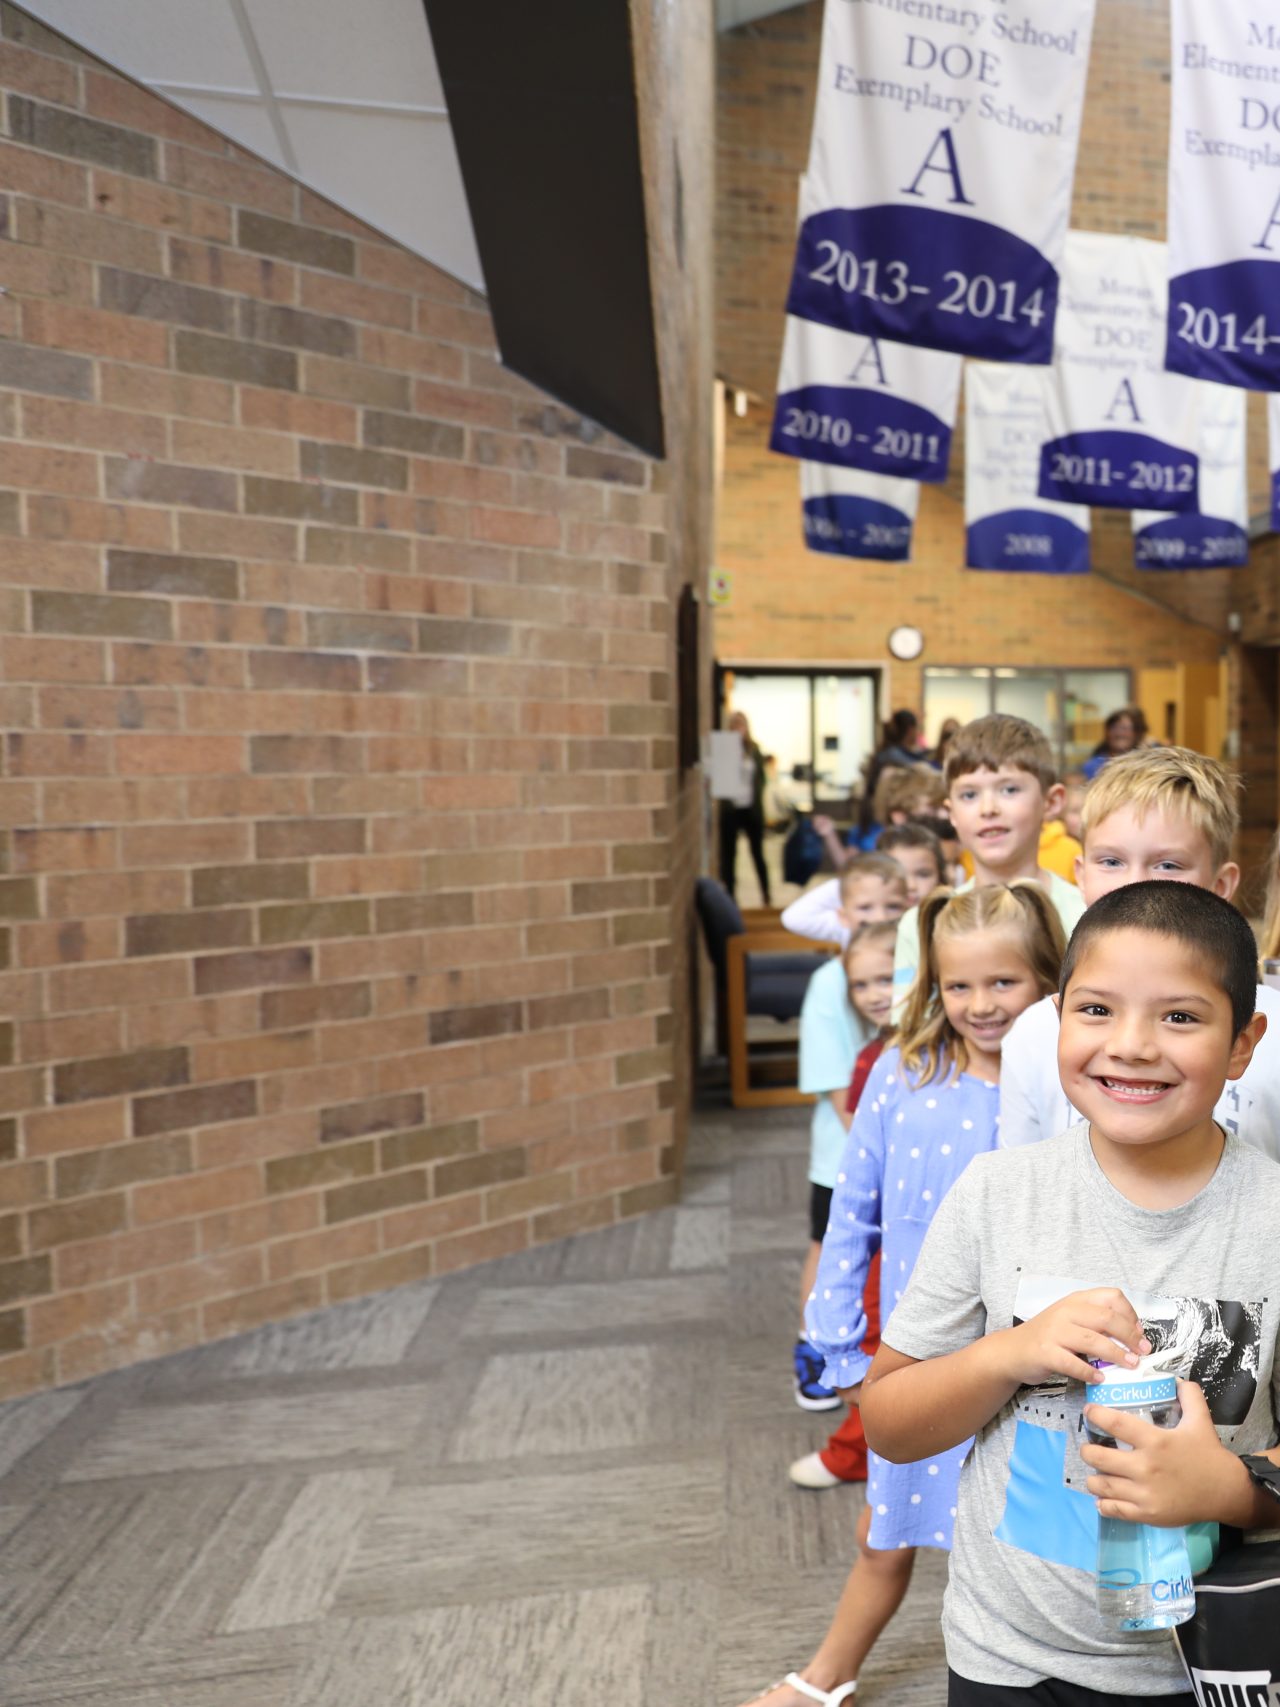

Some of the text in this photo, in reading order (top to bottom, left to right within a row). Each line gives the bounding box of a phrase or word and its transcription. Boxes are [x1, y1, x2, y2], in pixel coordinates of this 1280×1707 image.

[846, 0, 1078, 55] mentary School
[904, 34, 1002, 88] DOE
[833, 63, 1064, 137] Exemplary School
[900, 127, 974, 206] A
[847, 338, 889, 385] A
[1106, 378, 1143, 423] A
[1110, 1386, 1152, 1401] Cirkul
